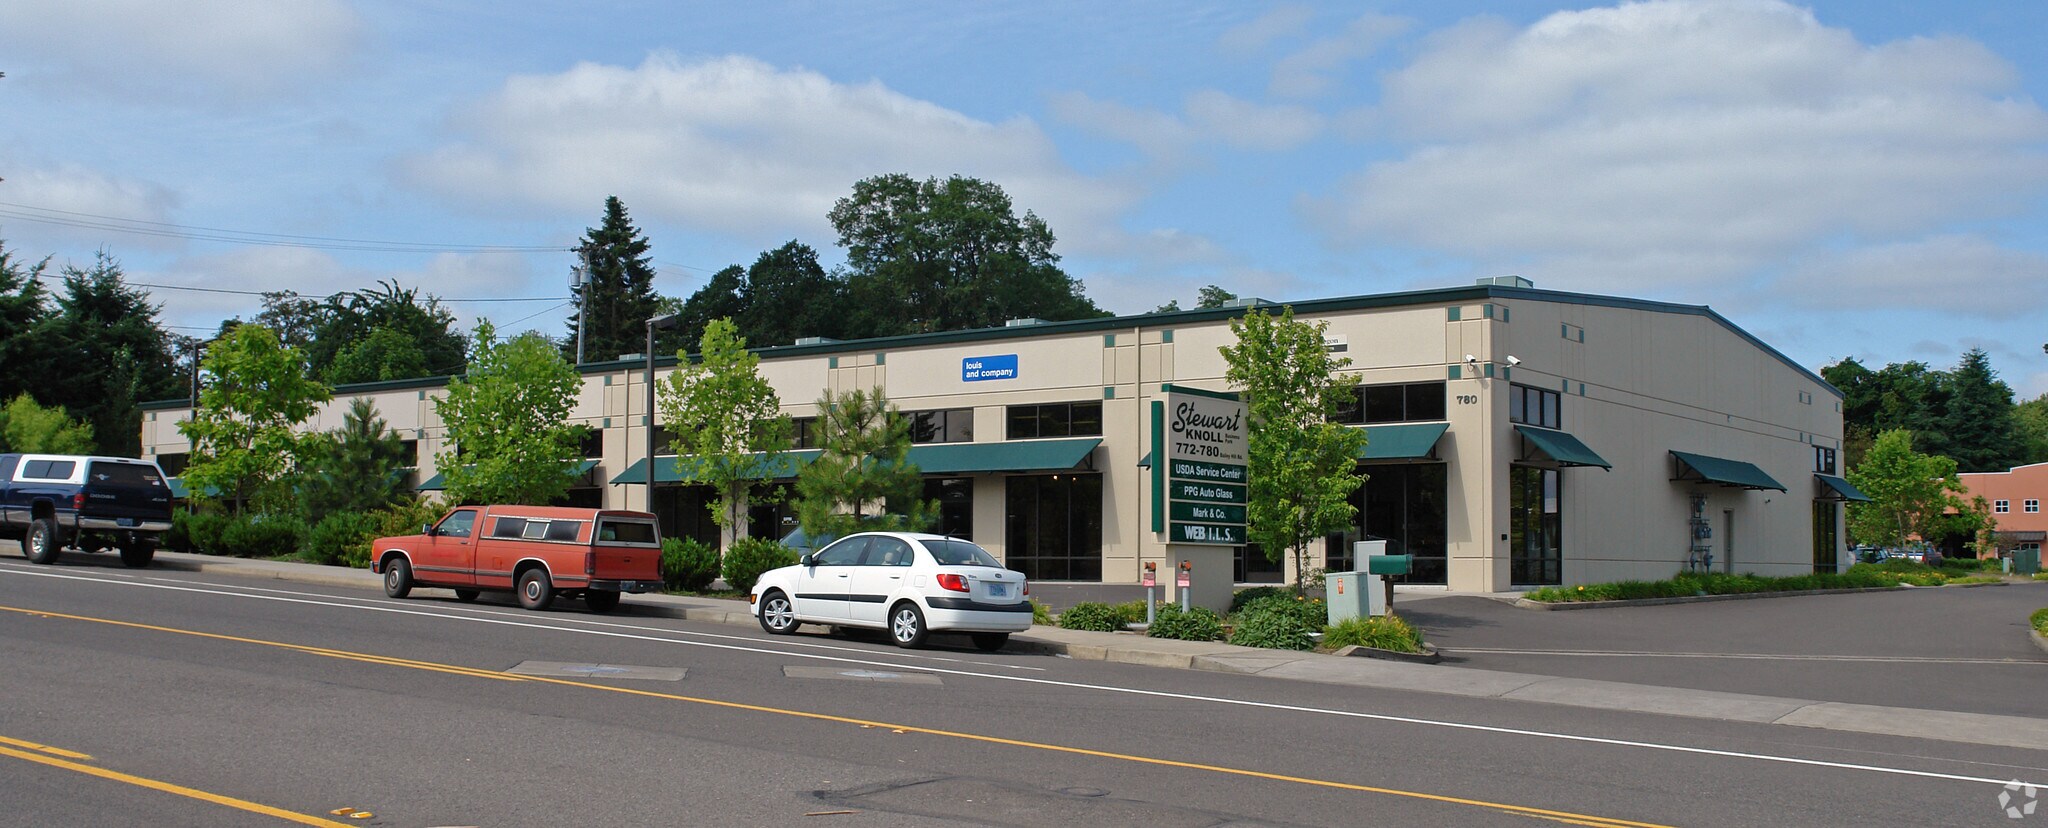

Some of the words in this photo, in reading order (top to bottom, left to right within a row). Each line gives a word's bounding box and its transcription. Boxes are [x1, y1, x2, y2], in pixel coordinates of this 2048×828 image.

[966, 361, 982, 369] louis
[966, 370, 979, 378] and
[981, 369, 1013, 377] company
[1456, 395, 1478, 405] 780
[1172, 401, 1241, 432] Stewart
[1185, 429, 1224, 443] KNOLL
[1176, 443, 1219, 457] 772-780
[1175, 463, 1195, 475] USDA
[1196, 465, 1219, 477] Service
[1220, 468, 1241, 479] Center
[1184, 485, 1198, 496] PPG
[1199, 487, 1214, 497] Auto
[1215, 488, 1233, 499] Glass
[1192, 507, 1208, 518] Mark
[1209, 508, 1214, 518] &
[1215, 509, 1226, 519] Co.
[1184, 525, 1205, 540] WEB
